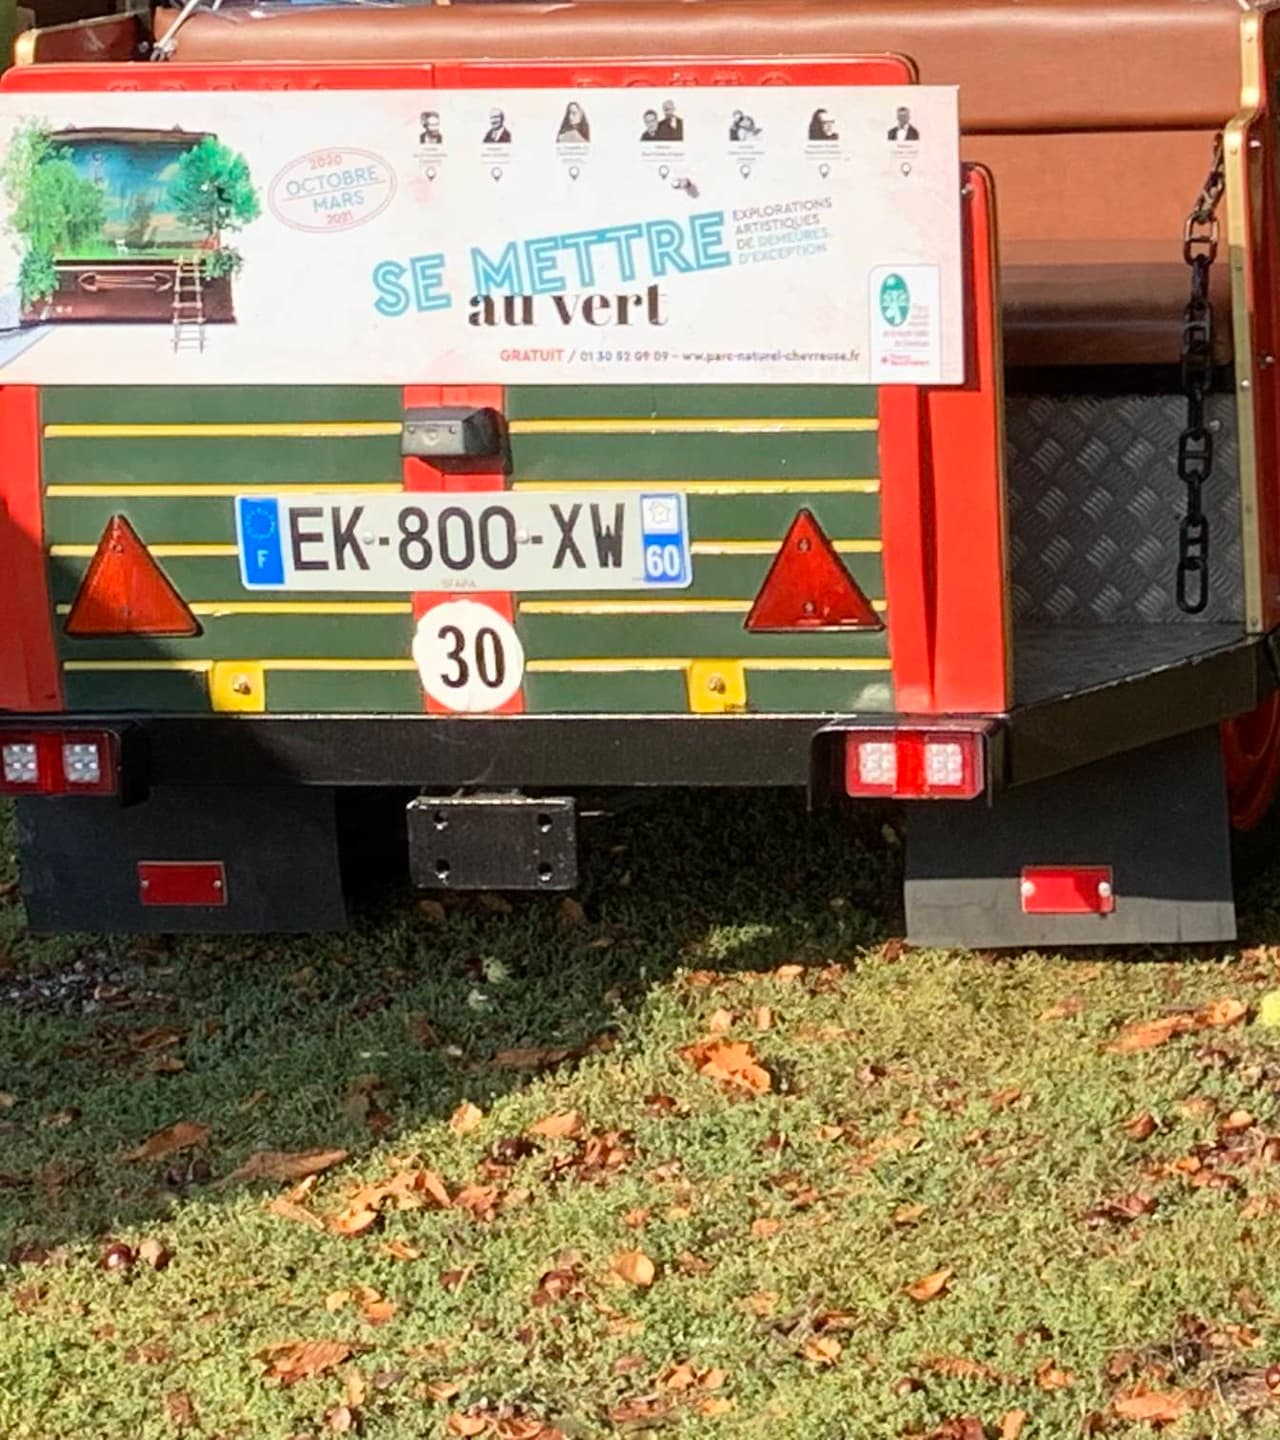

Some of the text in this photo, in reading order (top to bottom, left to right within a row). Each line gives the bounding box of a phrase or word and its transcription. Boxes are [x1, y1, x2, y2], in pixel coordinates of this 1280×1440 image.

[309, 154, 343, 170] 2020
[285, 164, 379, 196] OCTOBRE
[312, 189, 365, 213] MARS
[732, 197, 832, 221] EXPLORATIONS
[735, 213, 820, 235] ARTISTIQUES
[736, 226, 829, 250] DE DEMEURES
[373, 210, 731, 317] SE METTRE
[738, 243, 827, 265] D'EXCEPTION
[468, 283, 669, 327] au vert
[499, 348, 564, 363] GRATUIT
[580, 350, 593, 362] 01
[288, 502, 625, 571] EK-800-XW
[257, 550, 269, 569] F
[646, 544, 680, 578] 60
[437, 624, 505, 689] 30
